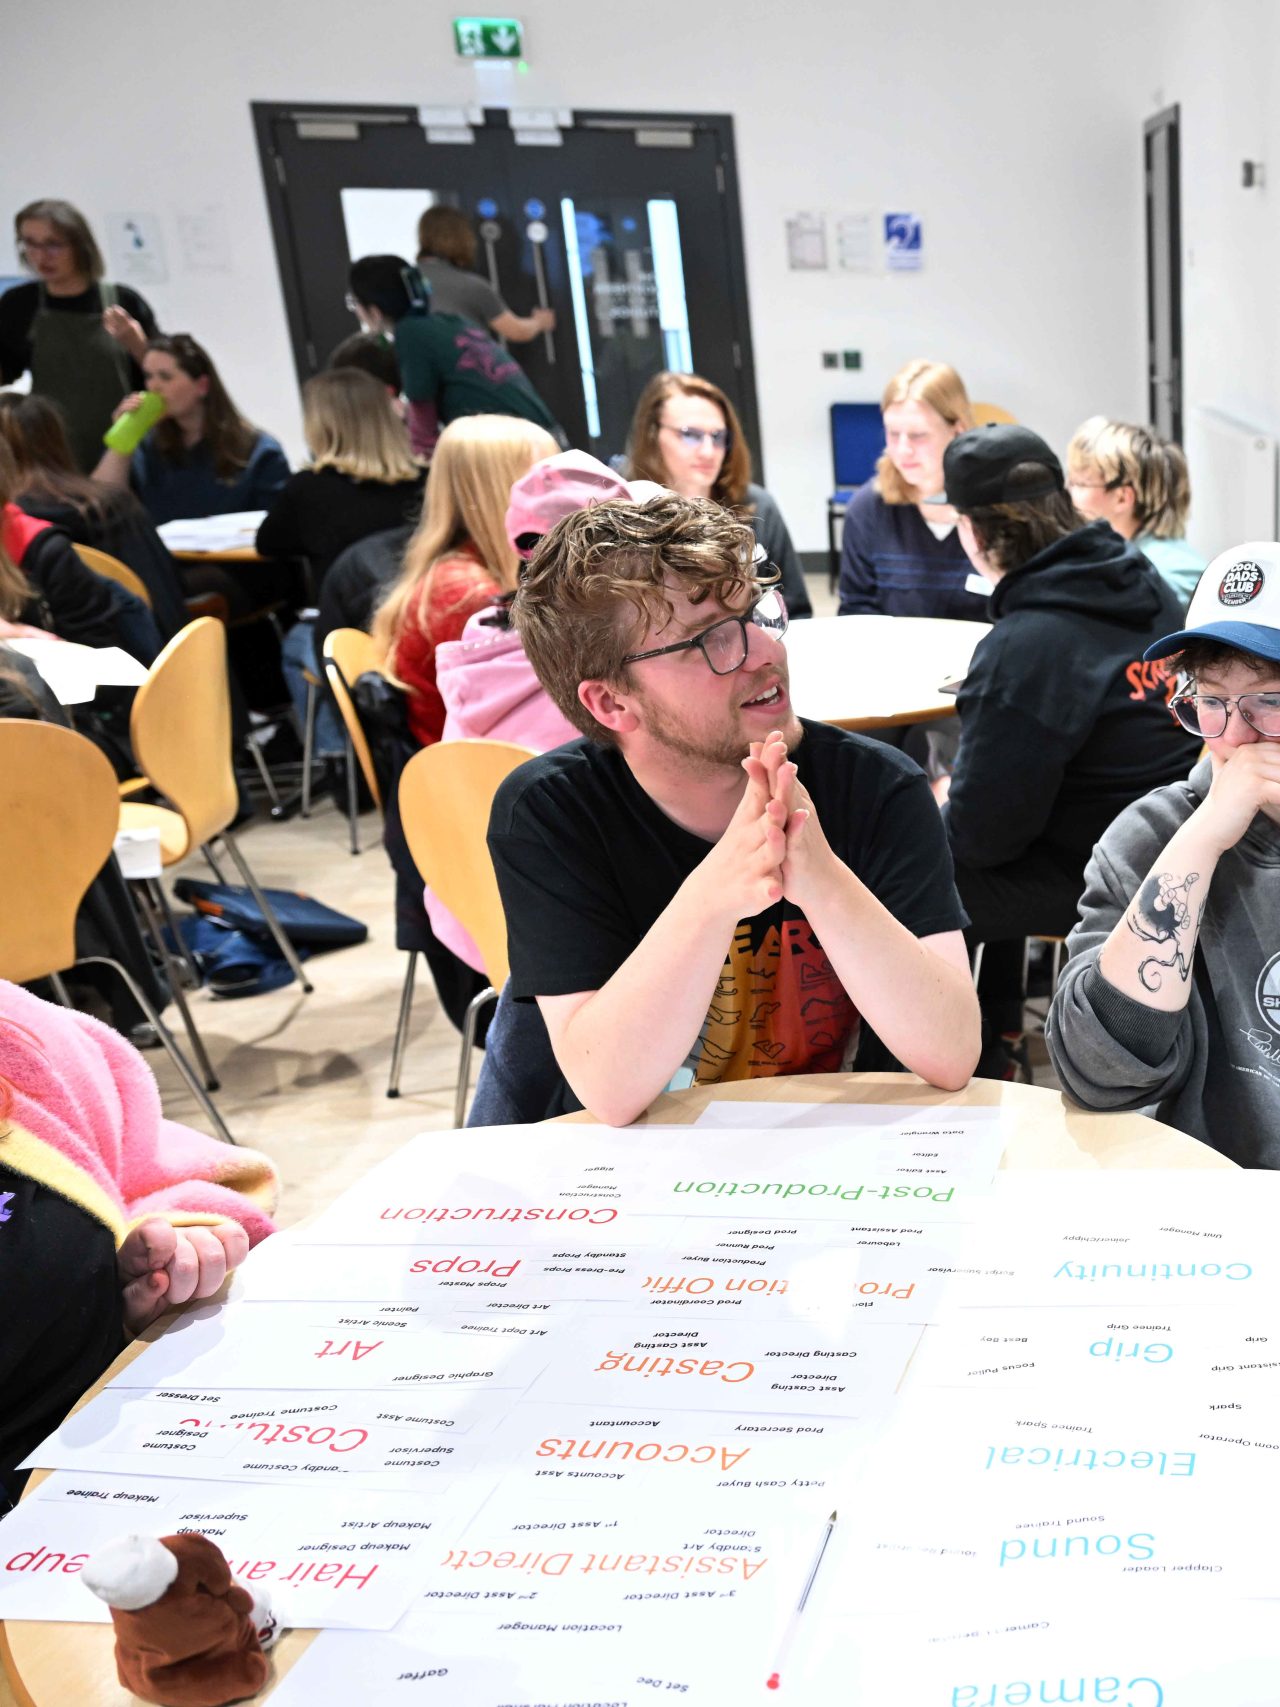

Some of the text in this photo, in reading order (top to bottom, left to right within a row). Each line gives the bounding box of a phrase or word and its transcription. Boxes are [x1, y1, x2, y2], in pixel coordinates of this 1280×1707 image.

[1231, 562, 1258, 572] COOL
[1226, 571, 1259, 582] DADS
[1223, 581, 1254, 593] CLUB
[576, 1183, 618, 1191] Manager
[673, 1181, 955, 1203] Post-Production
[379, 1207, 619, 1225] Construction
[1159, 1226, 1201, 1236] Manager
[584, 1251, 627, 1259] Standby
[681, 1255, 767, 1266] Production Buyer
[409, 1255, 522, 1278] Props
[1053, 1260, 1253, 1282] Continuity
[477, 1280, 508, 1288] Props
[724, 1278, 916, 1300] Protion
[486, 1302, 531, 1310] Director
[338, 1318, 408, 1328] Scenic Artist
[1106, 1323, 1130, 1331] Grip
[460, 1324, 549, 1337] Art Dept Trainee
[1244, 1336, 1268, 1344] Grip
[314, 1340, 385, 1361] Art
[633, 1342, 678, 1350] Casting
[1088, 1336, 1174, 1364] Grip
[764, 1350, 857, 1359] Casting Director
[593, 1350, 755, 1383] Casting
[1001, 1362, 1035, 1371] Focus
[1211, 1365, 1234, 1373] Grip
[391, 1370, 494, 1382] Graphic Designer
[790, 1374, 838, 1382] Director
[770, 1383, 846, 1393] Asst Casting
[155, 1392, 221, 1403] Set Dresser
[1209, 1402, 1242, 1411] Spark
[229, 1404, 338, 1420] Costume Trainee
[376, 1413, 455, 1427] Costume Asst
[733, 1424, 794, 1433] Secretary
[1015, 1420, 1093, 1434] Trainee Spark
[155, 1428, 209, 1439] Designer
[1199, 1433, 1251, 1447] Operator
[142, 1442, 197, 1451] Costume
[388, 1445, 455, 1455] Supervisor
[535, 1438, 751, 1473] Accounts
[985, 1446, 1197, 1477] Electrical
[242, 1463, 298, 1472] Costume
[534, 1470, 625, 1480] Accounts Asst
[716, 1479, 752, 1488] Buyer
[755, 1480, 787, 1488] Cash
[65, 1489, 160, 1503] Makeup Trainee
[178, 1512, 249, 1522] Supervisor
[1015, 1515, 1105, 1529] Sound Trainee
[340, 1520, 432, 1531] Makeup Artist
[512, 1522, 567, 1531] Director
[570, 1520, 602, 1529] Asst
[703, 1528, 756, 1538] Director
[297, 1541, 411, 1553] Makeup Designer
[682, 1543, 705, 1551] Art
[999, 1532, 1156, 1570] Sound
[580, 1550, 769, 1581] Assistant
[1122, 1563, 1223, 1573] Clapper Loader
[278, 1562, 380, 1591] Hair
[424, 1591, 481, 1600] Director
[483, 1591, 517, 1600] Asst
[623, 1592, 680, 1601] Director
[684, 1591, 716, 1599] Asst
[497, 1621, 623, 1633] Location Manager
[1005, 1621, 1050, 1632] Camer
[397, 1667, 449, 1681] Gaffer
[636, 1676, 690, 1693] Set Dec
[951, 1676, 1165, 1707] Camera
